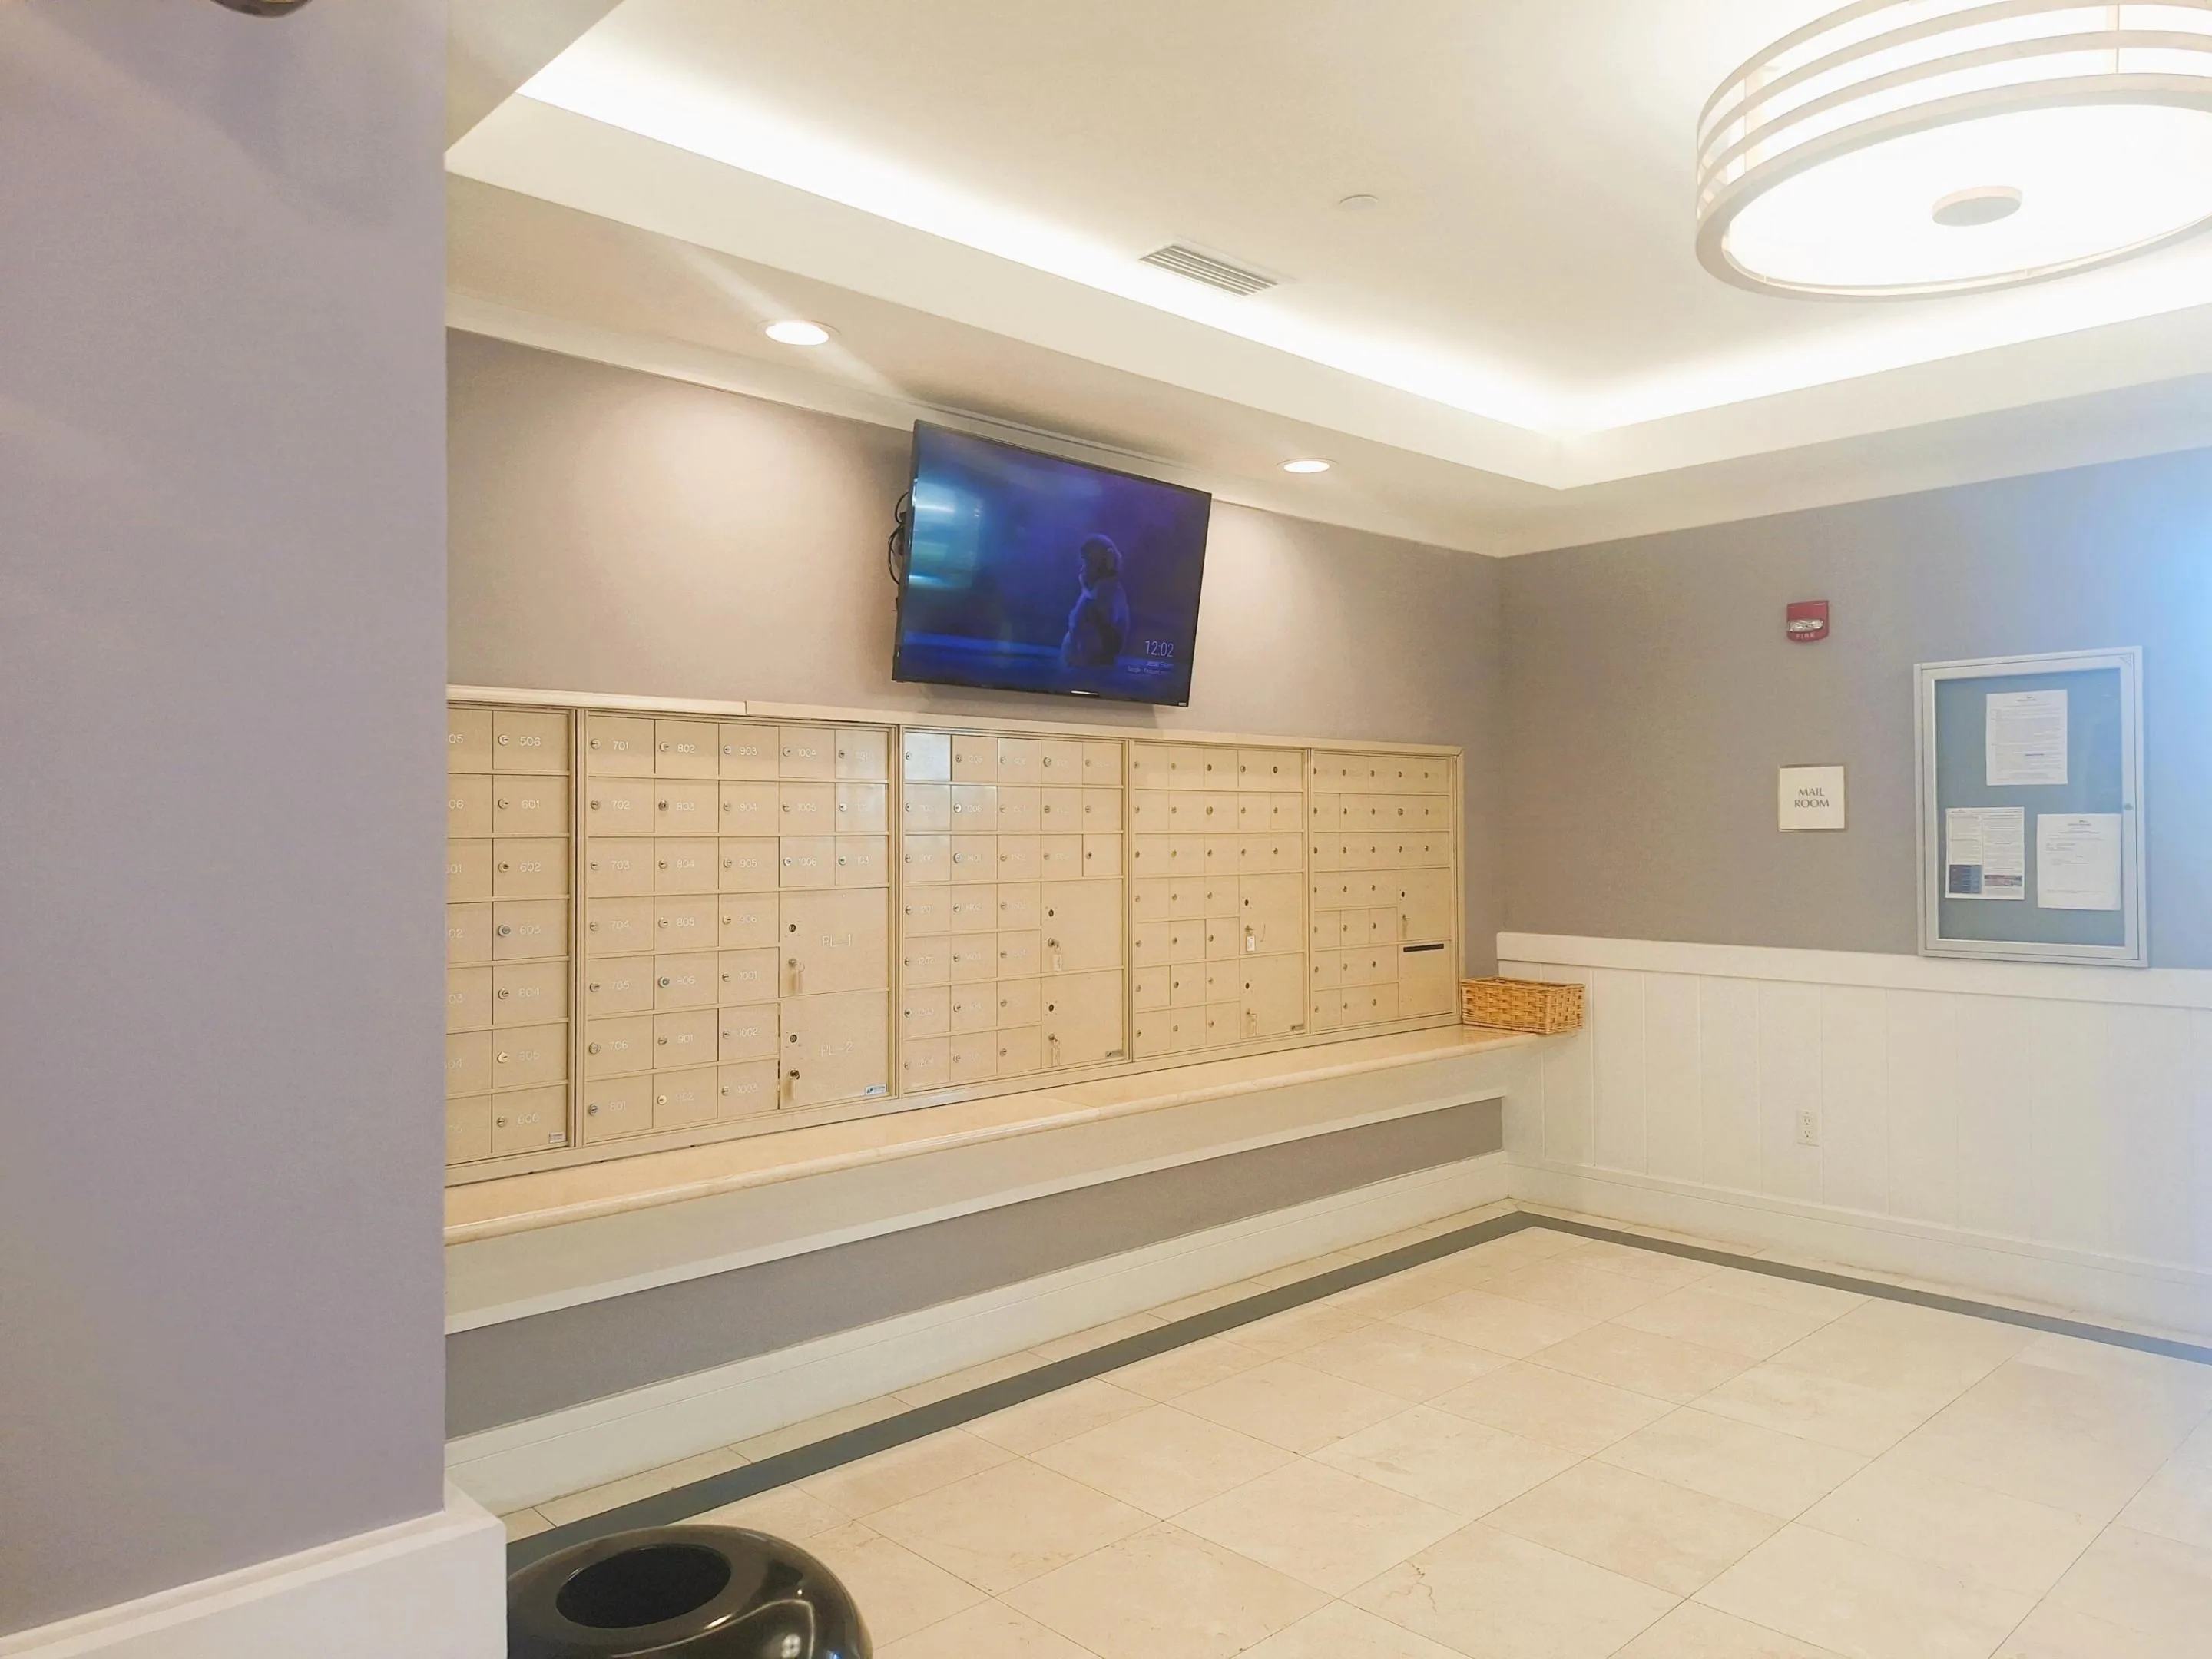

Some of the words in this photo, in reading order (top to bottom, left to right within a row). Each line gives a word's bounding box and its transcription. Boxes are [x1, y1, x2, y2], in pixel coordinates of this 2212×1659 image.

[1145, 640, 1174, 658] 12:02
[519, 737, 541, 747] 506
[613, 741, 630, 751] 701
[677, 745, 696, 754] 802
[740, 747, 757, 757] 903
[798, 749, 817, 757] 1004
[1799, 787, 1825, 796] MAIL
[521, 800, 541, 810] 601
[612, 800, 631, 810] 702
[676, 802, 695, 812] 803
[1794, 799, 1830, 808] ROOM
[677, 859, 695, 869] 804
[739, 859, 757, 868] 905
[798, 857, 817, 866] 1006
[519, 862, 541, 873] 602
[676, 916, 695, 927] 805
[677, 1033, 694, 1045] 901
[609, 1039, 628, 1051] 706
